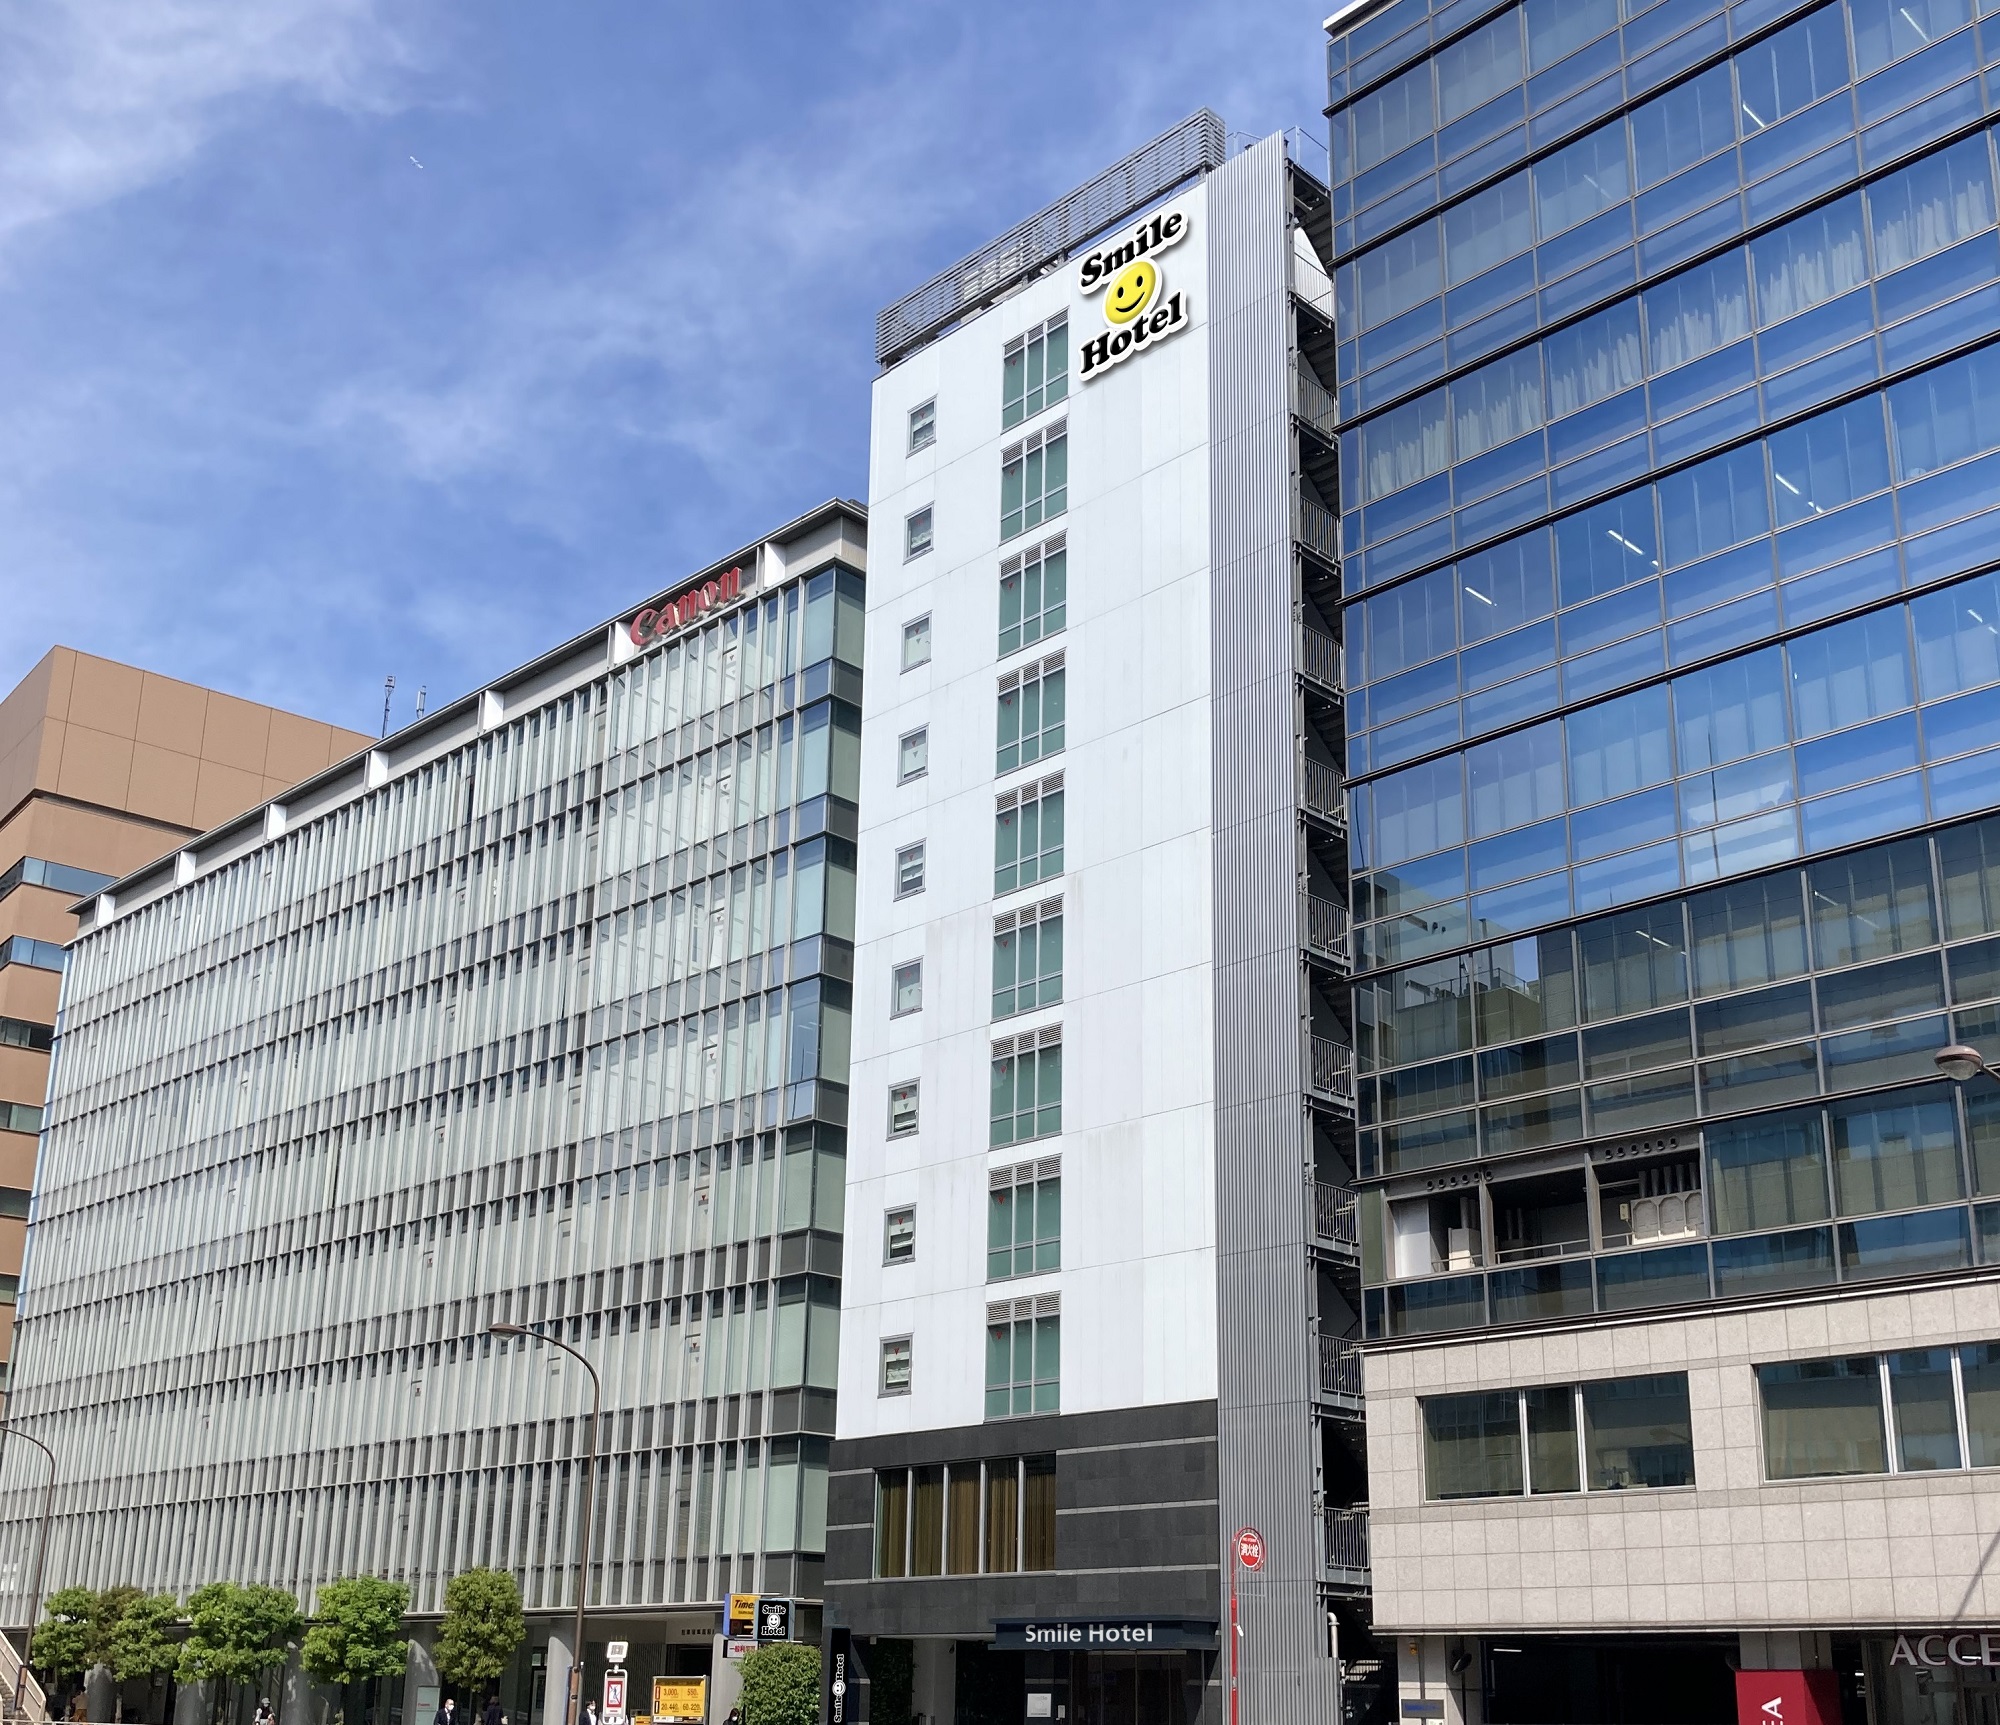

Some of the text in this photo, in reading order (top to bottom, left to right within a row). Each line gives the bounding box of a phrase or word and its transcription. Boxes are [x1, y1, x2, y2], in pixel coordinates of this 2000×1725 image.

[1080, 213, 1182, 288] Smile
[1080, 291, 1183, 374] Hotel
[630, 566, 742, 646] Canon
[734, 1599, 755, 1609] Time
[762, 1604, 786, 1615] Smile
[761, 1625, 786, 1636] Hotel
[1025, 1622, 1153, 1642] Smile Hotel
[1889, 1633, 2000, 1666] ACCE
[833, 1653, 845, 1723] Smile Hotel
